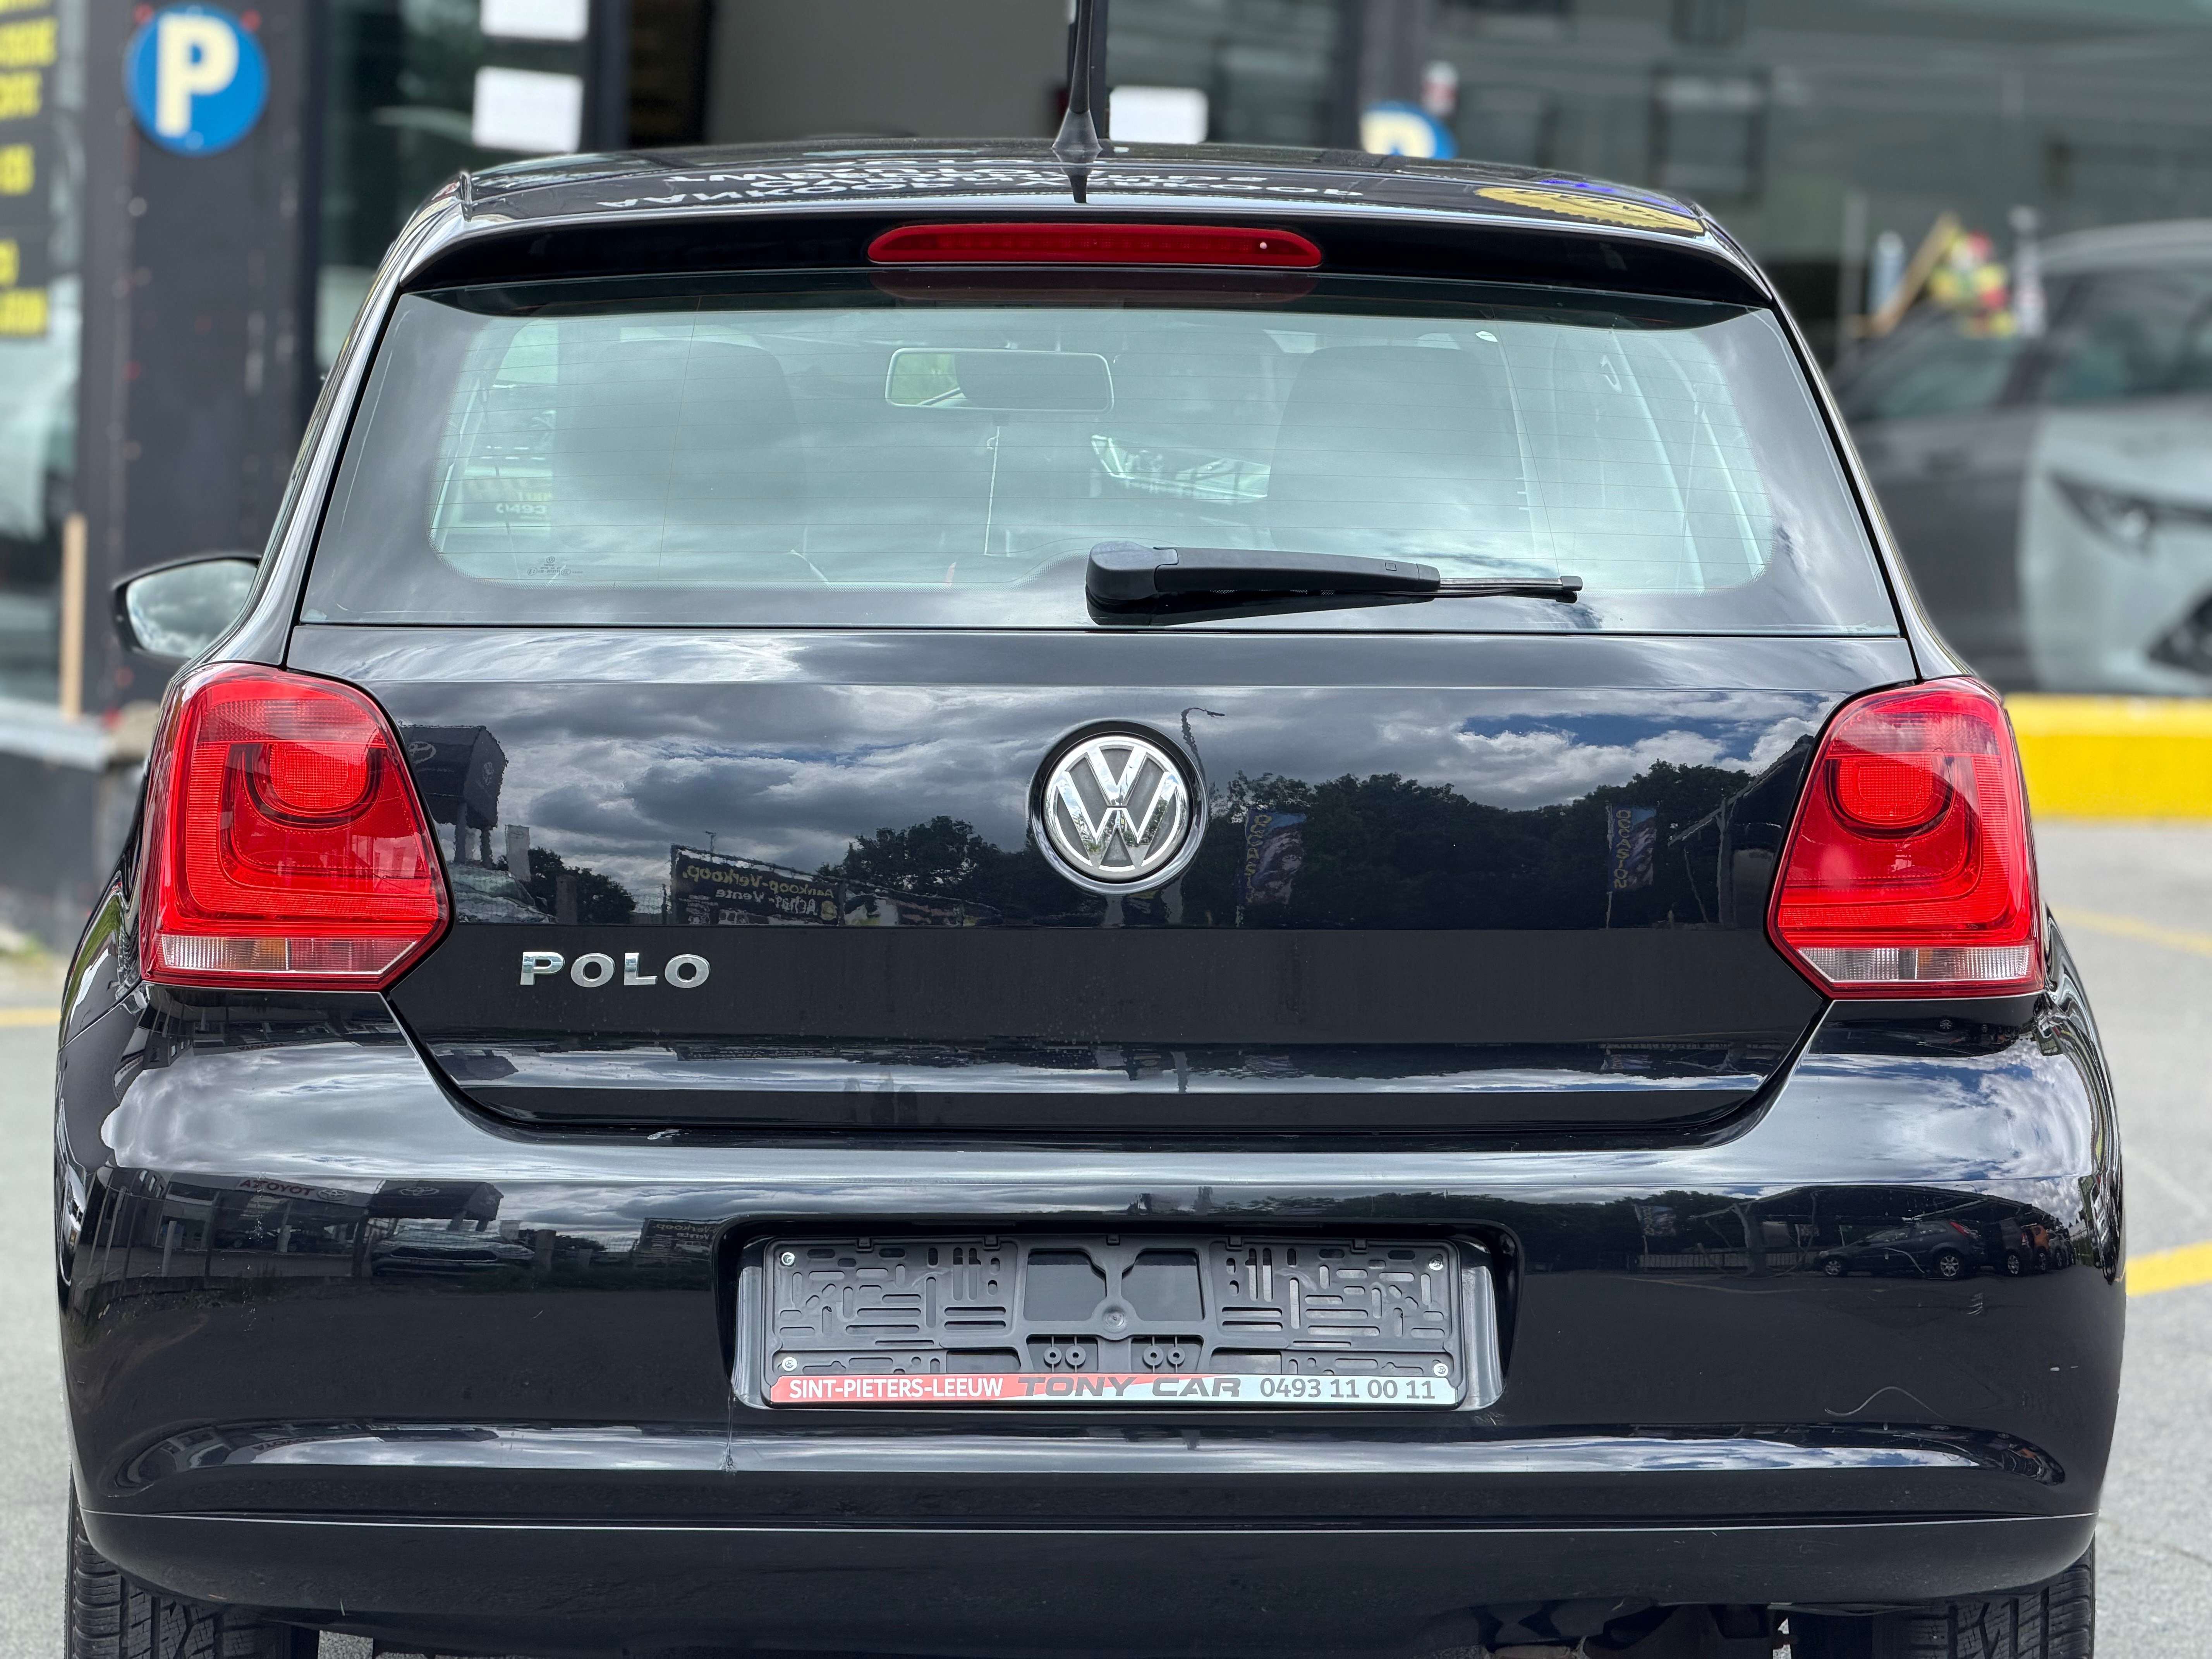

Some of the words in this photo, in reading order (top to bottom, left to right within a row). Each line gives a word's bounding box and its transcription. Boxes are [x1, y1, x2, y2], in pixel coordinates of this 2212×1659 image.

[155, 12, 240, 137] P
[520, 951, 711, 988] POLO
[789, 1377, 1003, 1398] SINT-PIETERS-LEEUW
[1018, 1377, 1137, 1396] TONY
[1152, 1377, 1241, 1397] CAR
[1260, 1378, 1321, 1398] 0493
[1331, 1379, 1360, 1398] 11
[1368, 1379, 1398, 1399] 00
[1406, 1380, 1436, 1400] 11
